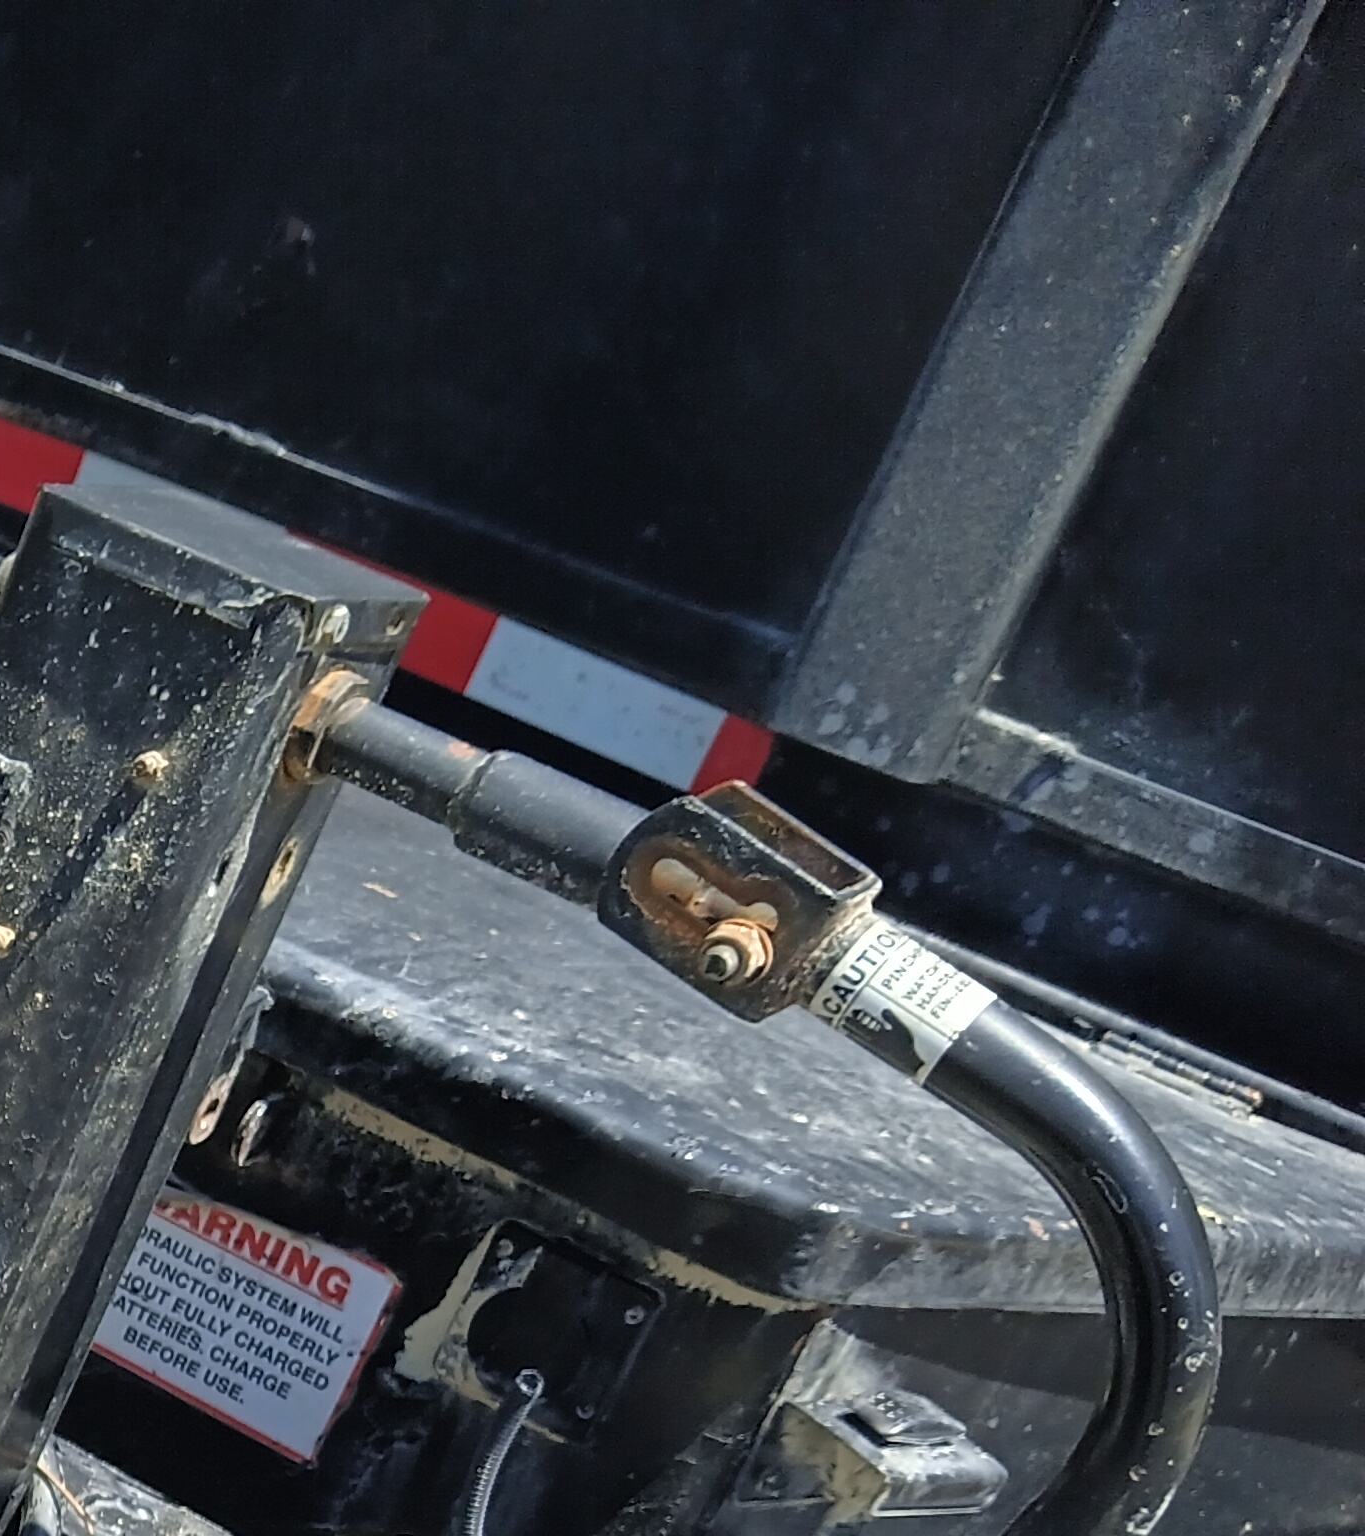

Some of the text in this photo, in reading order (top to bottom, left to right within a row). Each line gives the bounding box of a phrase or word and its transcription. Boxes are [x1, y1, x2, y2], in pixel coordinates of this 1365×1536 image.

[155, 1203, 353, 1307] ARNING
[113, 1297, 292, 1401] ATTERIES. CHARGE
[137, 1252, 340, 1368] FUNCTION PROPERLY
[172, 1300, 233, 1338] FULLY
[233, 1330, 330, 1392] CHARGED
[218, 1265, 299, 1318] SYSTEM
[300, 1307, 344, 1344] WILL
[123, 1327, 245, 1404] BEFORE USE.
